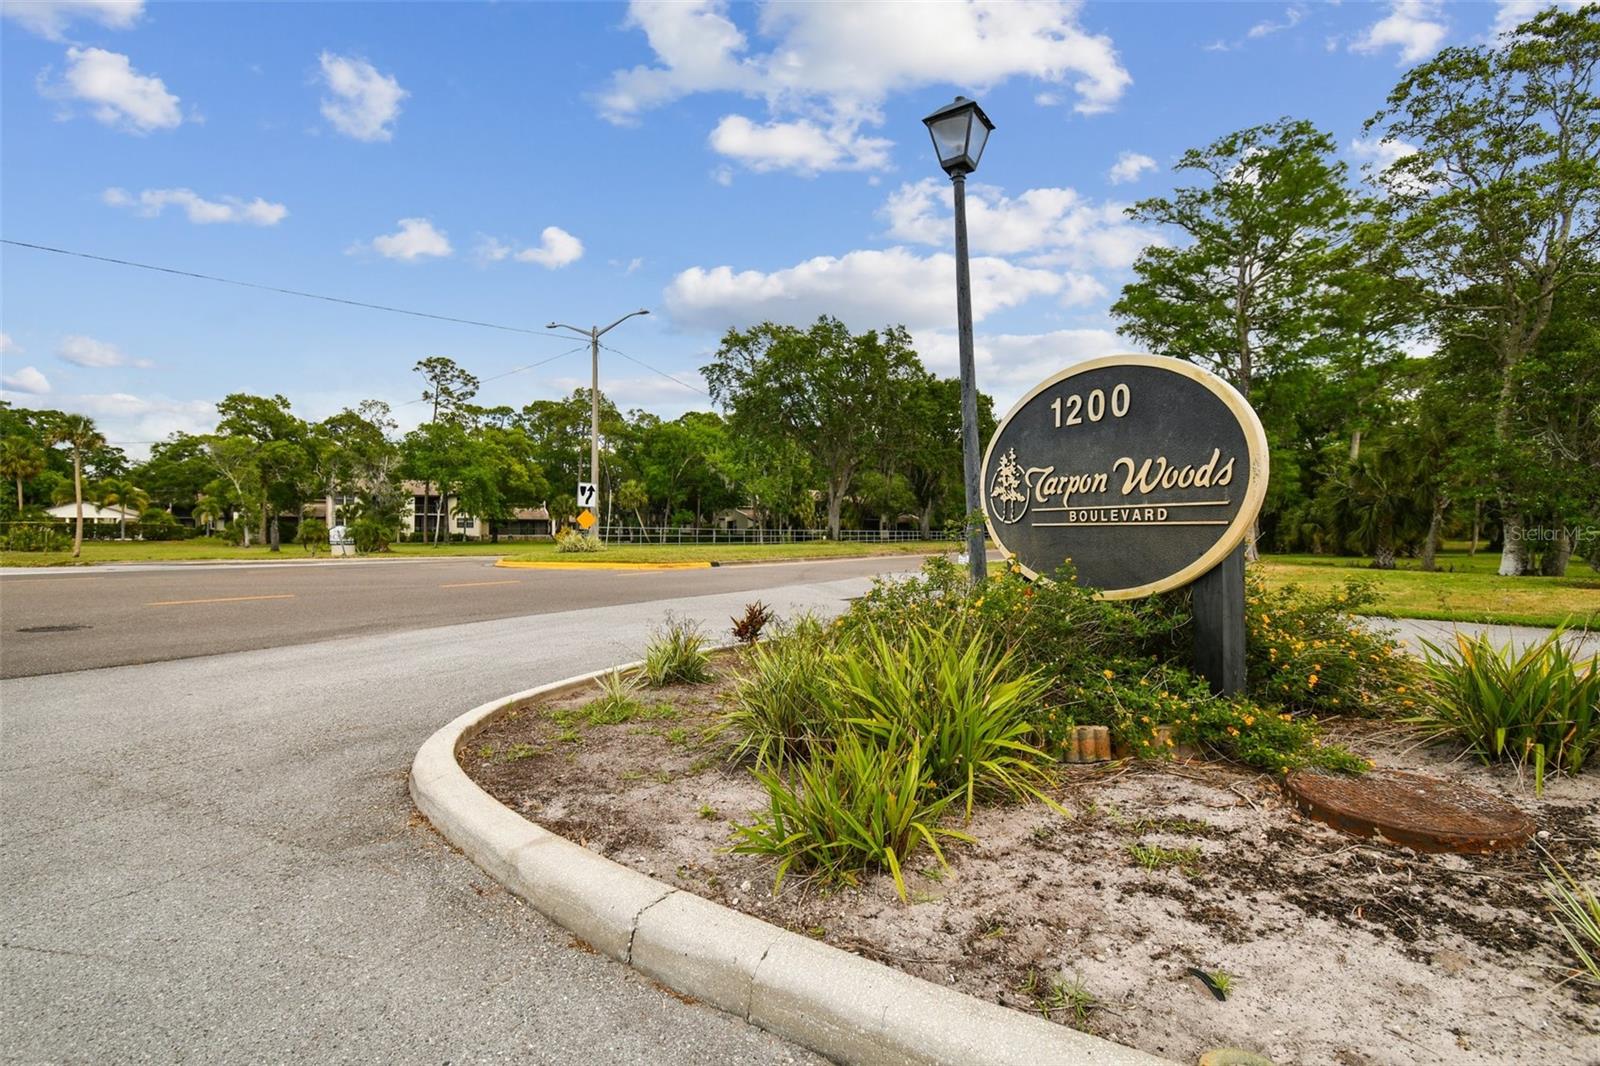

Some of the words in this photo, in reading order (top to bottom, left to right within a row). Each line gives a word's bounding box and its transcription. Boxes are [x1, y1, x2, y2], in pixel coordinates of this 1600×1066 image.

[1050, 383, 1131, 427] 1200
[1025, 466, 1107, 508] Tarpon
[1112, 448, 1235, 495] Woods
[1069, 508, 1168, 522] BOULEVARD
